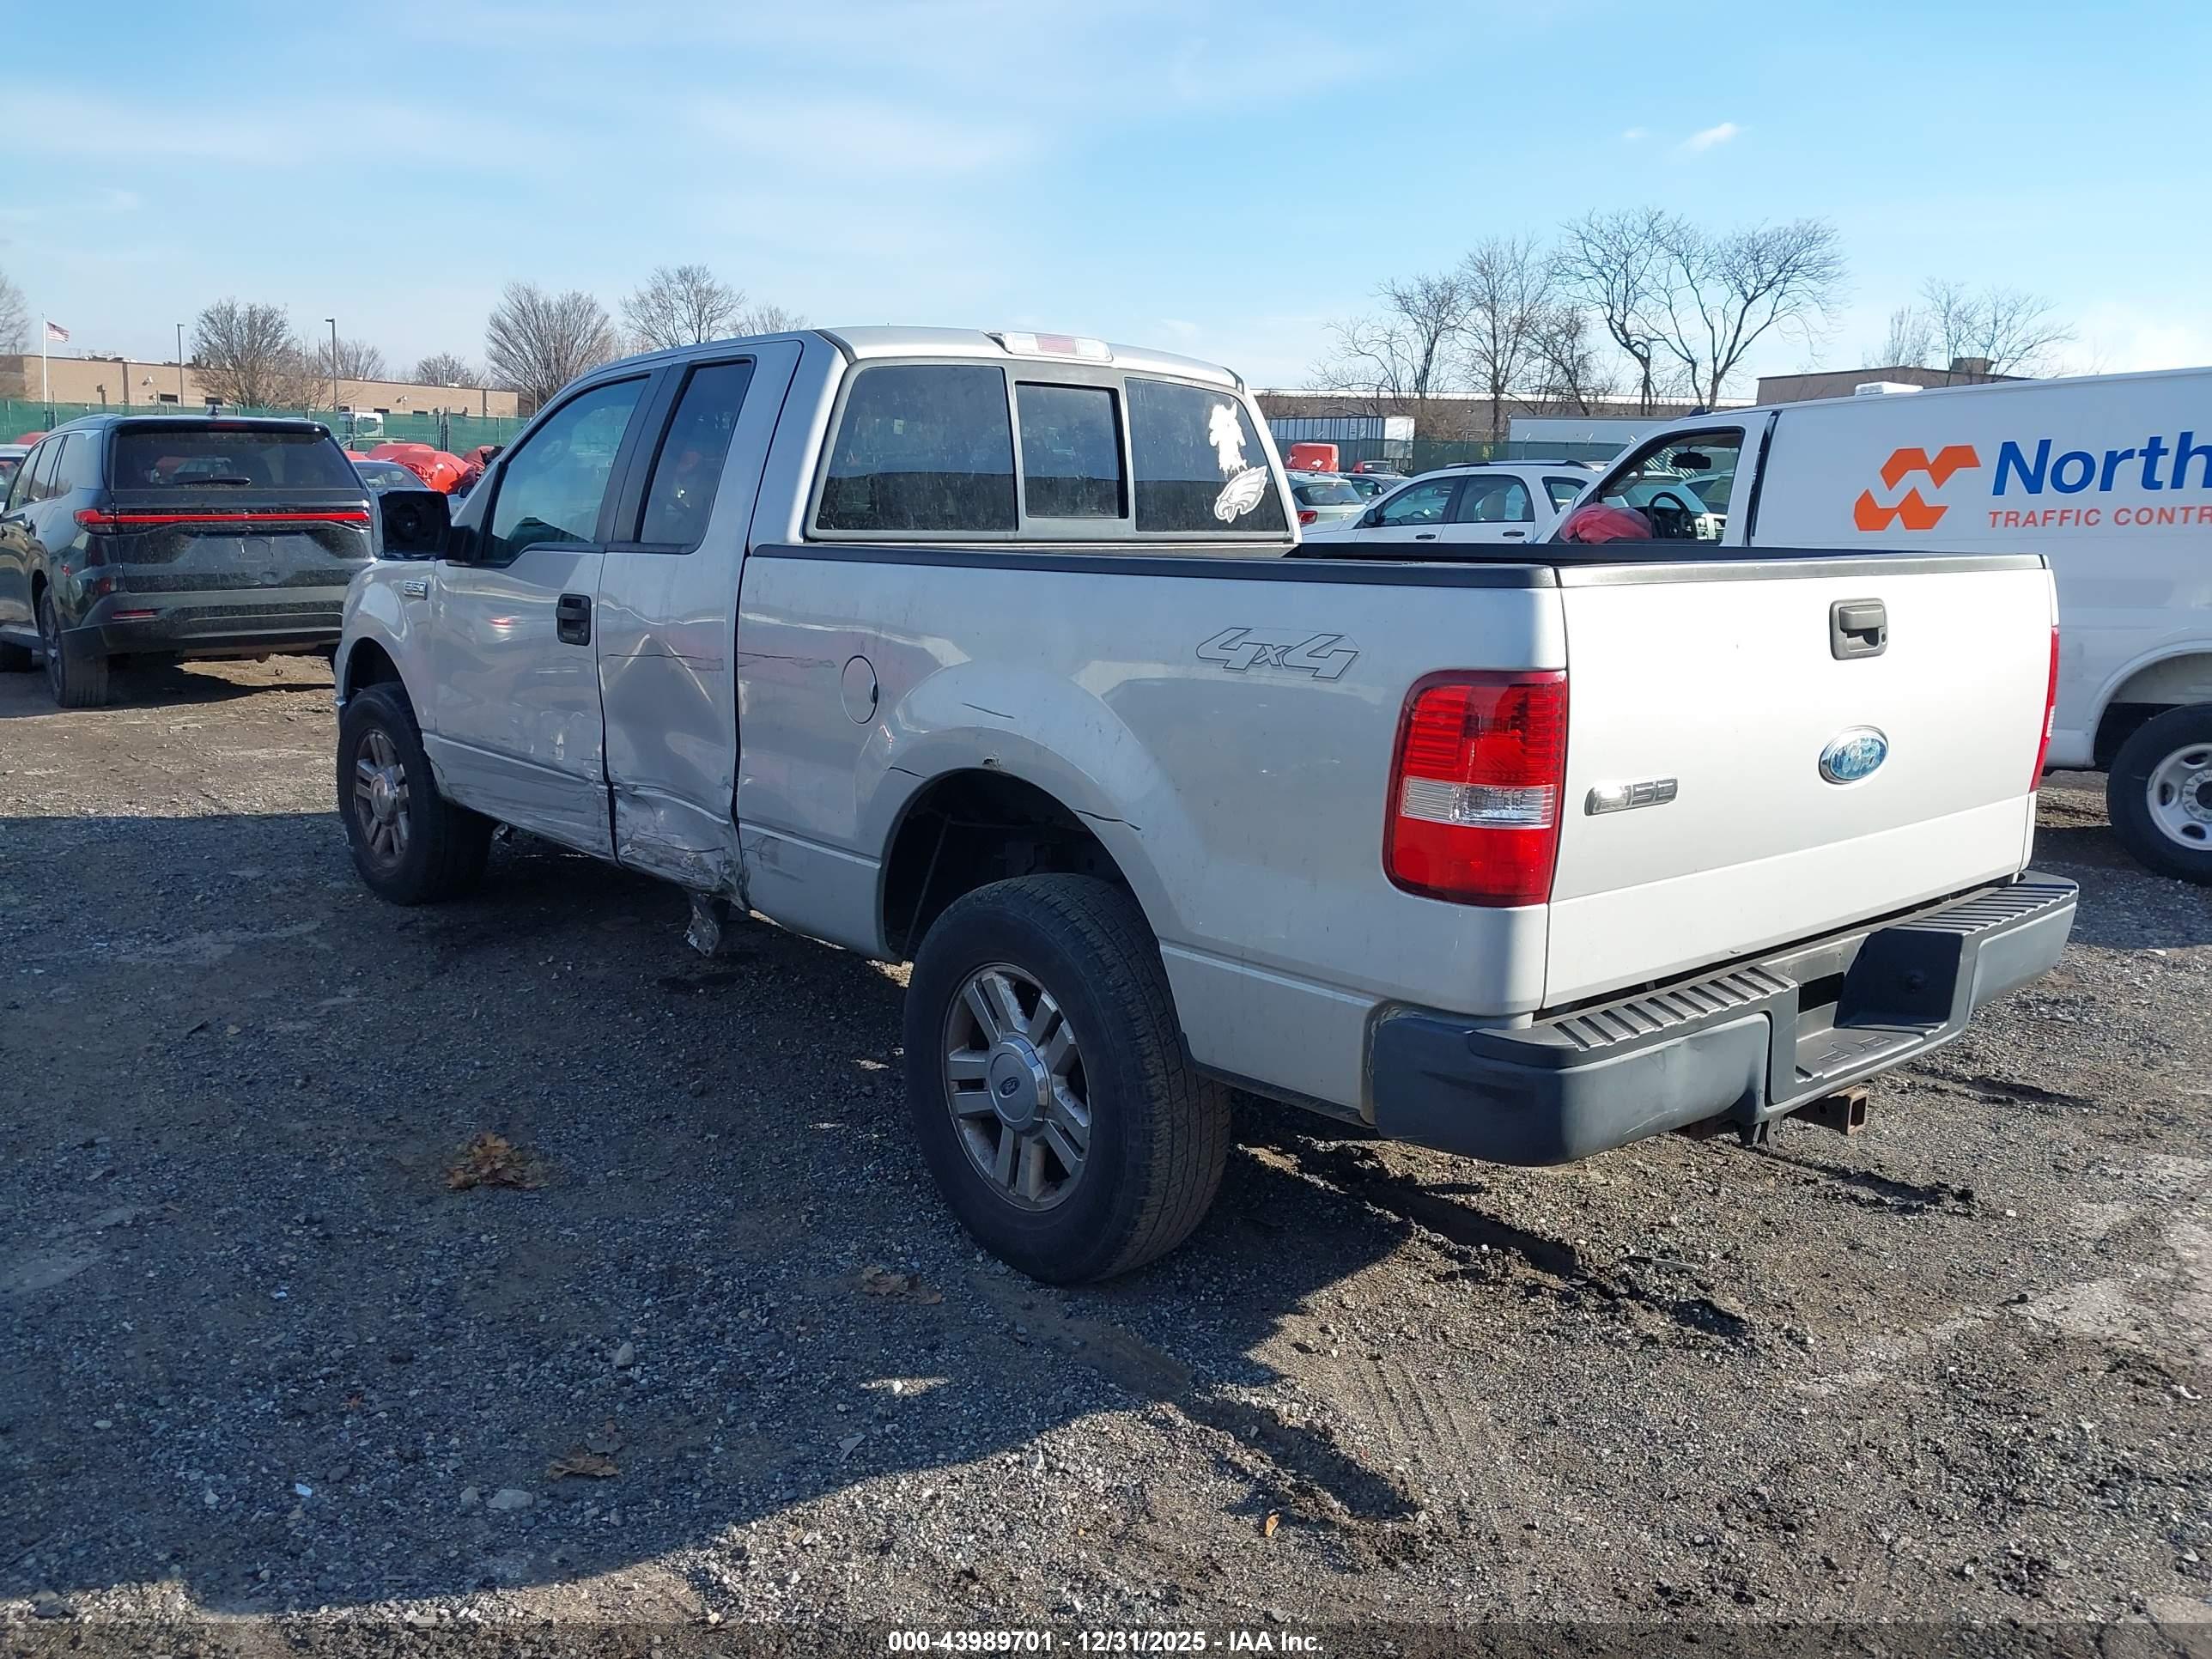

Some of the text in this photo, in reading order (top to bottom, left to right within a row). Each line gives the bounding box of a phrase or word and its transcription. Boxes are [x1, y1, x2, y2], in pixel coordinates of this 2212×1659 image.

[1991, 431, 2212, 496] North
[1990, 506, 2212, 528] TRAFFIC CONTR
[1195, 626, 1361, 680] 4x4
